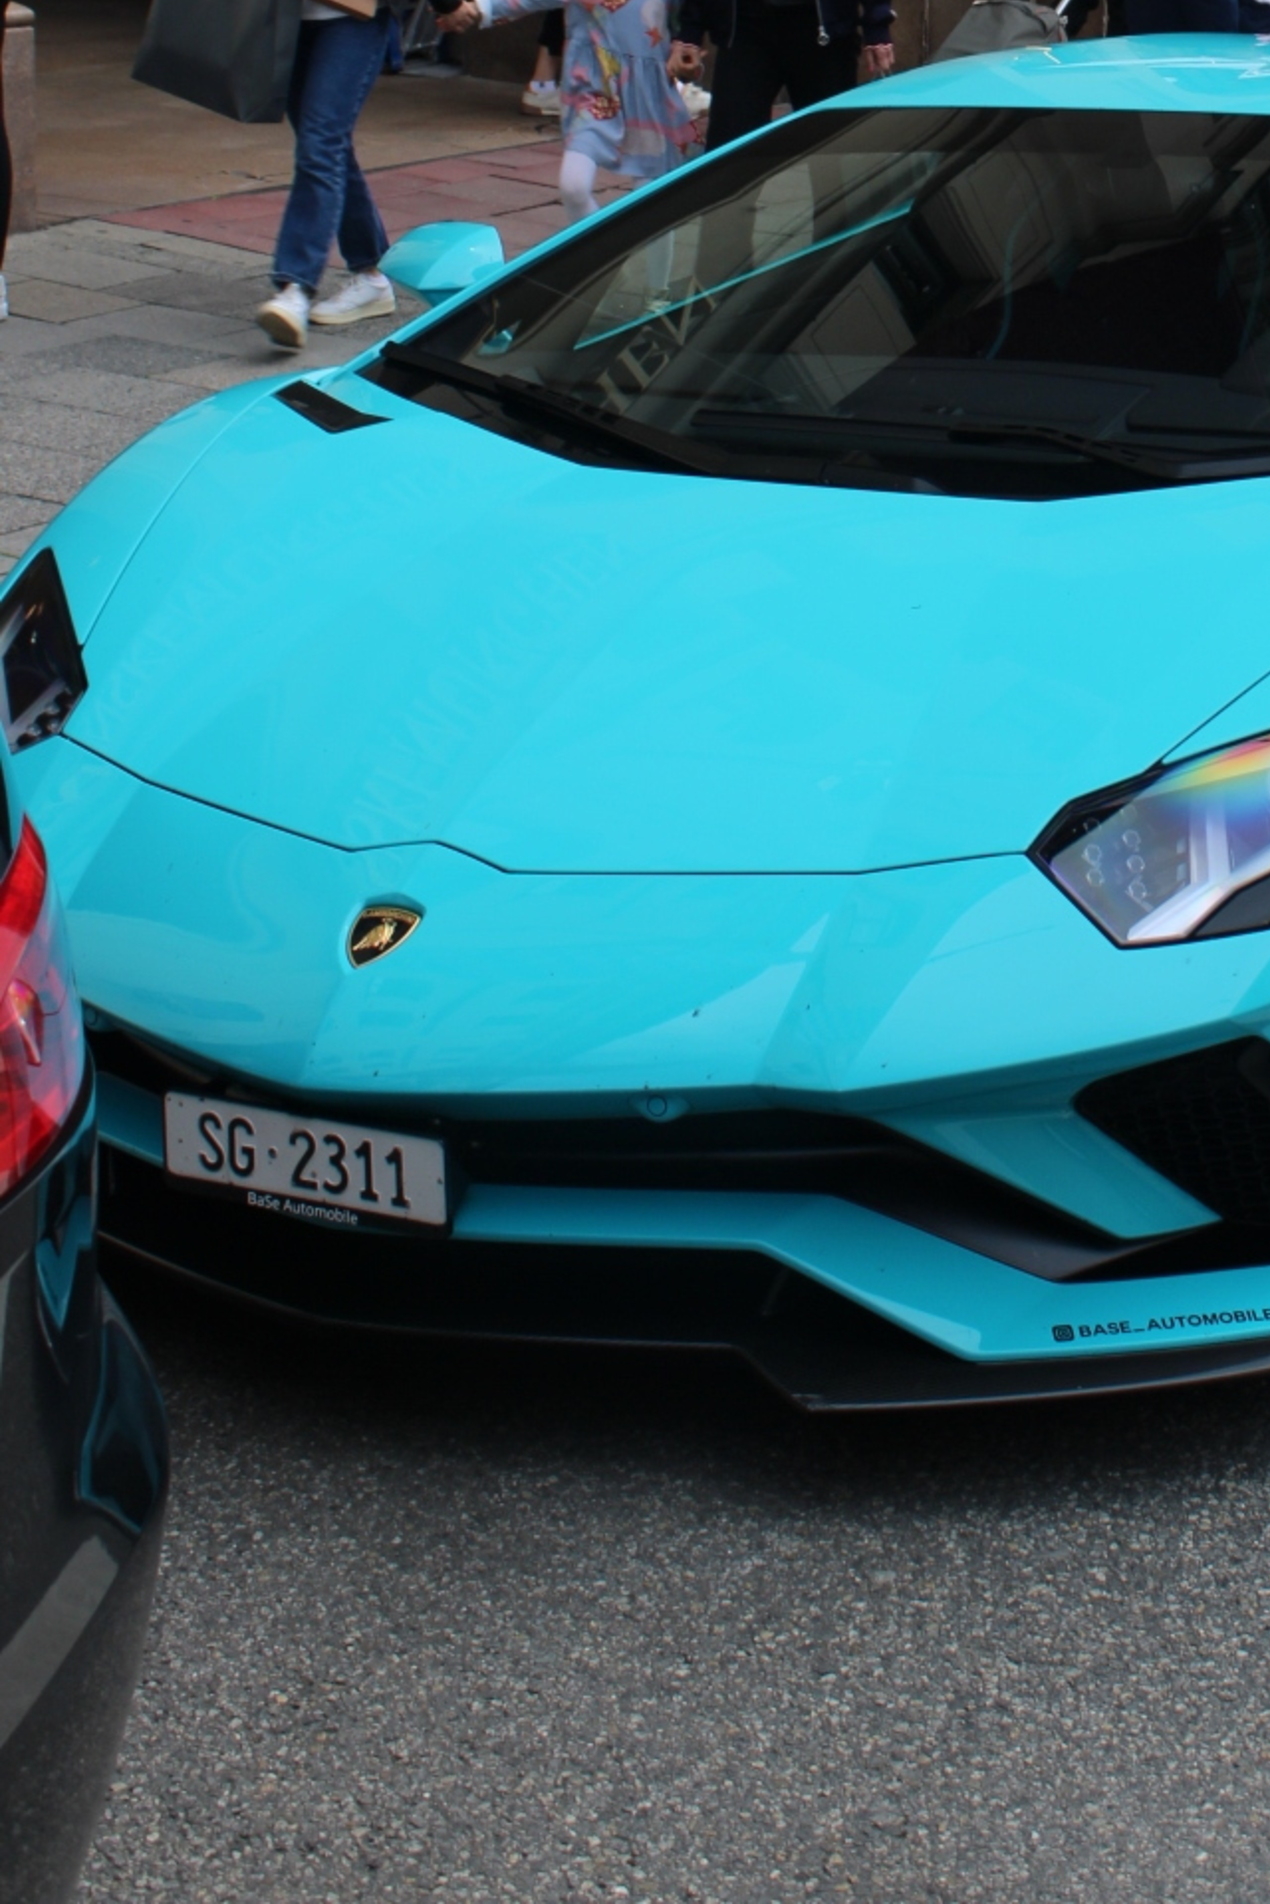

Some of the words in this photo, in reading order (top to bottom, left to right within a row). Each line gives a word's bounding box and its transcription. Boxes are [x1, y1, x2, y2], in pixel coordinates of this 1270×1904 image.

[289, 1128, 411, 1209] 2311
[247, 1191, 281, 1212] BaSe
[283, 1197, 359, 1226] Automobile
